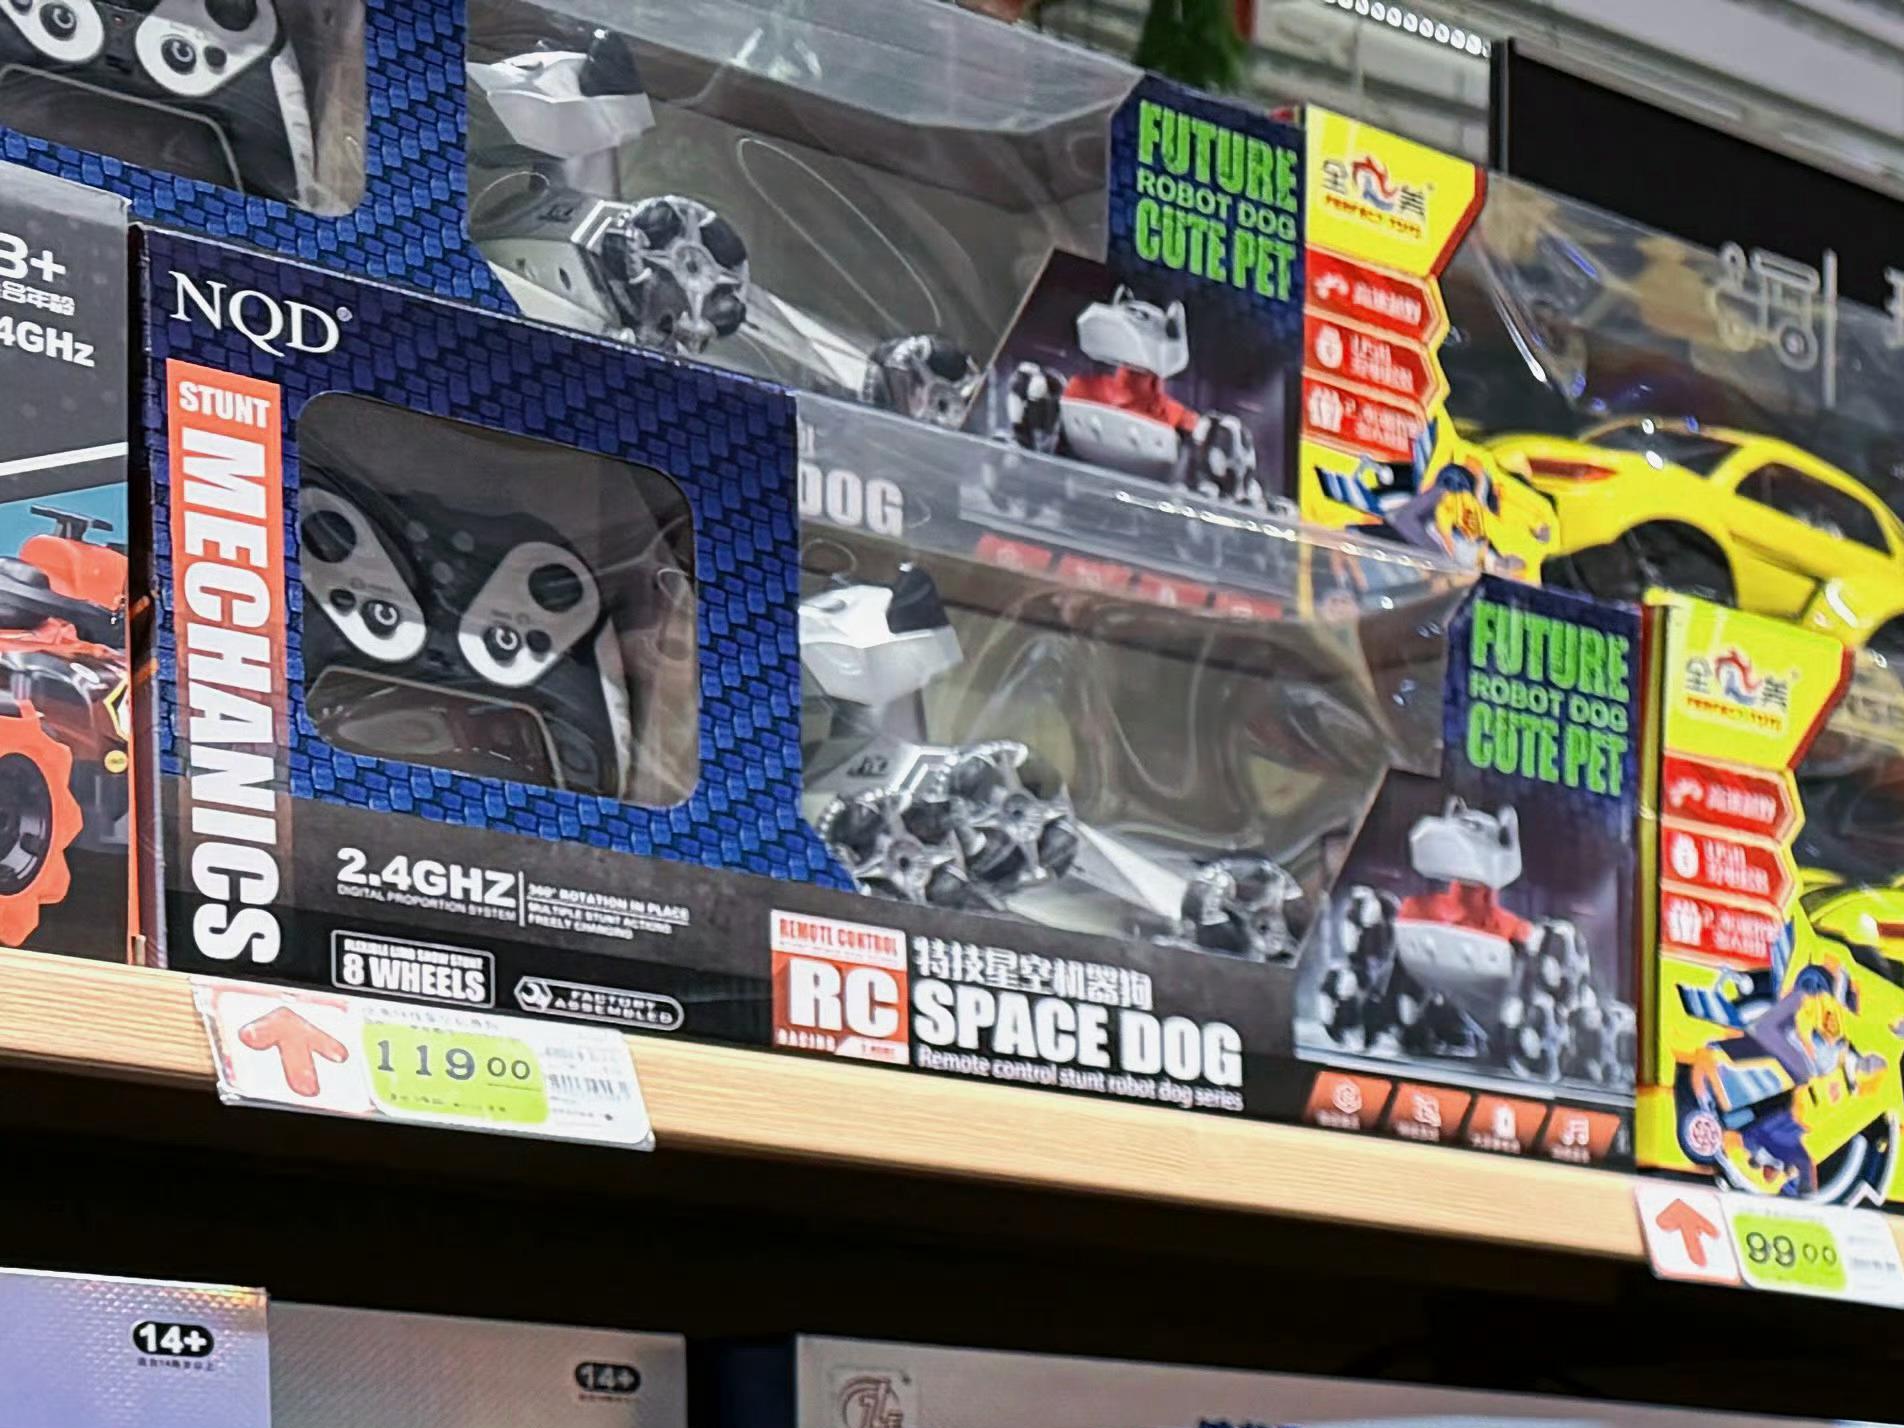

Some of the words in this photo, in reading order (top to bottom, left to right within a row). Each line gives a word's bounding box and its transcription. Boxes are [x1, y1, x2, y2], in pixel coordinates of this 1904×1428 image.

[1138, 99, 1298, 214] FUTURE
[1136, 166, 1232, 219] ROBOT
[1237, 200, 1297, 241] DOG
[1135, 196, 1228, 283] CUTE
[1231, 228, 1297, 302] PET
[167, 270, 340, 357] NQD
[178, 380, 271, 428] STUNT
[798, 460, 904, 537] DOG
[1472, 598, 1630, 701] FUTURE
[181, 427, 282, 966] MECHANICS
[1468, 670, 1563, 718] ROBOT
[1569, 694, 1629, 733] DOG
[1466, 702, 1560, 784] CUTE
[1563, 722, 1628, 797] PET
[337, 848, 517, 908] 2.4GHZ
[337, 883, 386, 902] DIGITAL
[387, 891, 463, 915] PROPORTION
[465, 904, 517, 922] SYSTEM
[648, 900, 690, 921] PLACE
[778, 917, 834, 946] REMOTE
[837, 928, 899, 955] CONTROL
[343, 952, 366, 986] 8
[369, 956, 486, 1001] WHEELS
[789, 959, 900, 1038] RC
[554, 997, 675, 1025] ASSEMBLED
[913, 977, 1111, 1069] SPACE
[1117, 1008, 1244, 1088] DOG
[377, 1040, 476, 1080] 119
[918, 1045, 990, 1078] Remote
[992, 1059, 1057, 1086] control
[1059, 1070, 1106, 1093] stunt
[1107, 1075, 1157, 1100] robot
[1158, 1084, 1194, 1109] dog
[1195, 1090, 1245, 1113] series
[1746, 1232, 1796, 1267] 99
[139, 1323, 208, 1354] 14+
[579, 1365, 636, 1391] 14+
